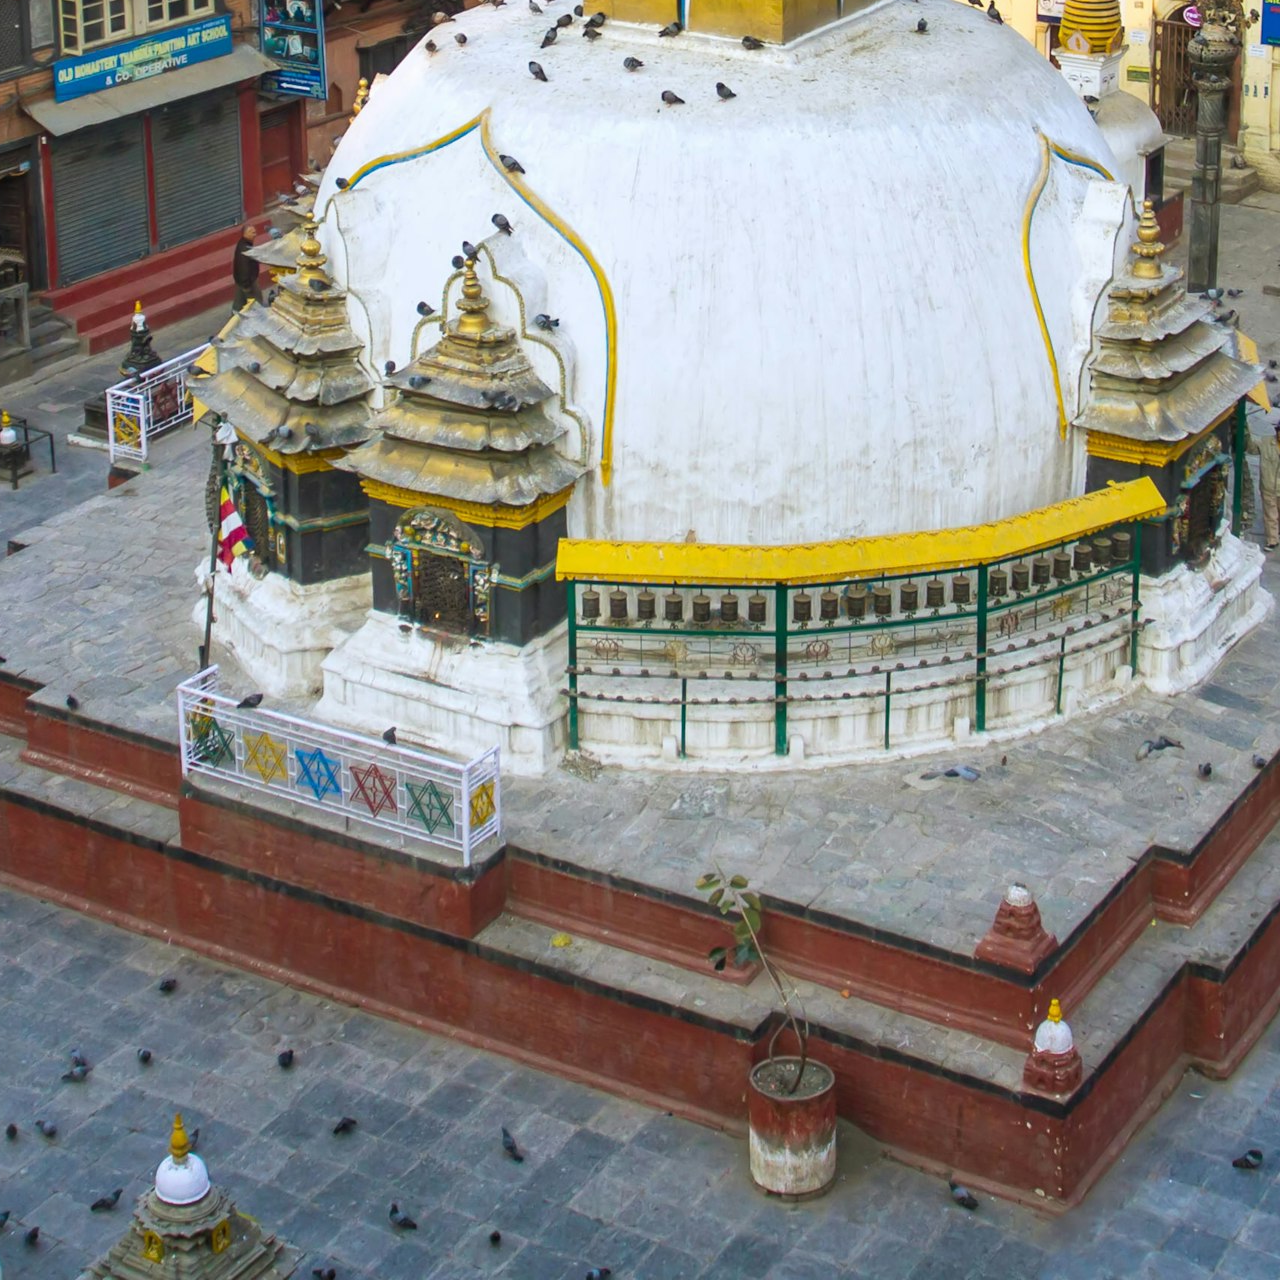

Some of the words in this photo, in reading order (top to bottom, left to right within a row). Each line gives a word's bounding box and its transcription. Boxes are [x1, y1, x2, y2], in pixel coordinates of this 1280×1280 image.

[58, 67, 73, 83] OLD
[74, 55, 118, 79] MONASTERY
[187, 31, 200, 47] ART
[201, 24, 228, 43] SCHOOL
[106, 75, 113, 86] &
[136, 54, 188, 78] OPERATIVE
